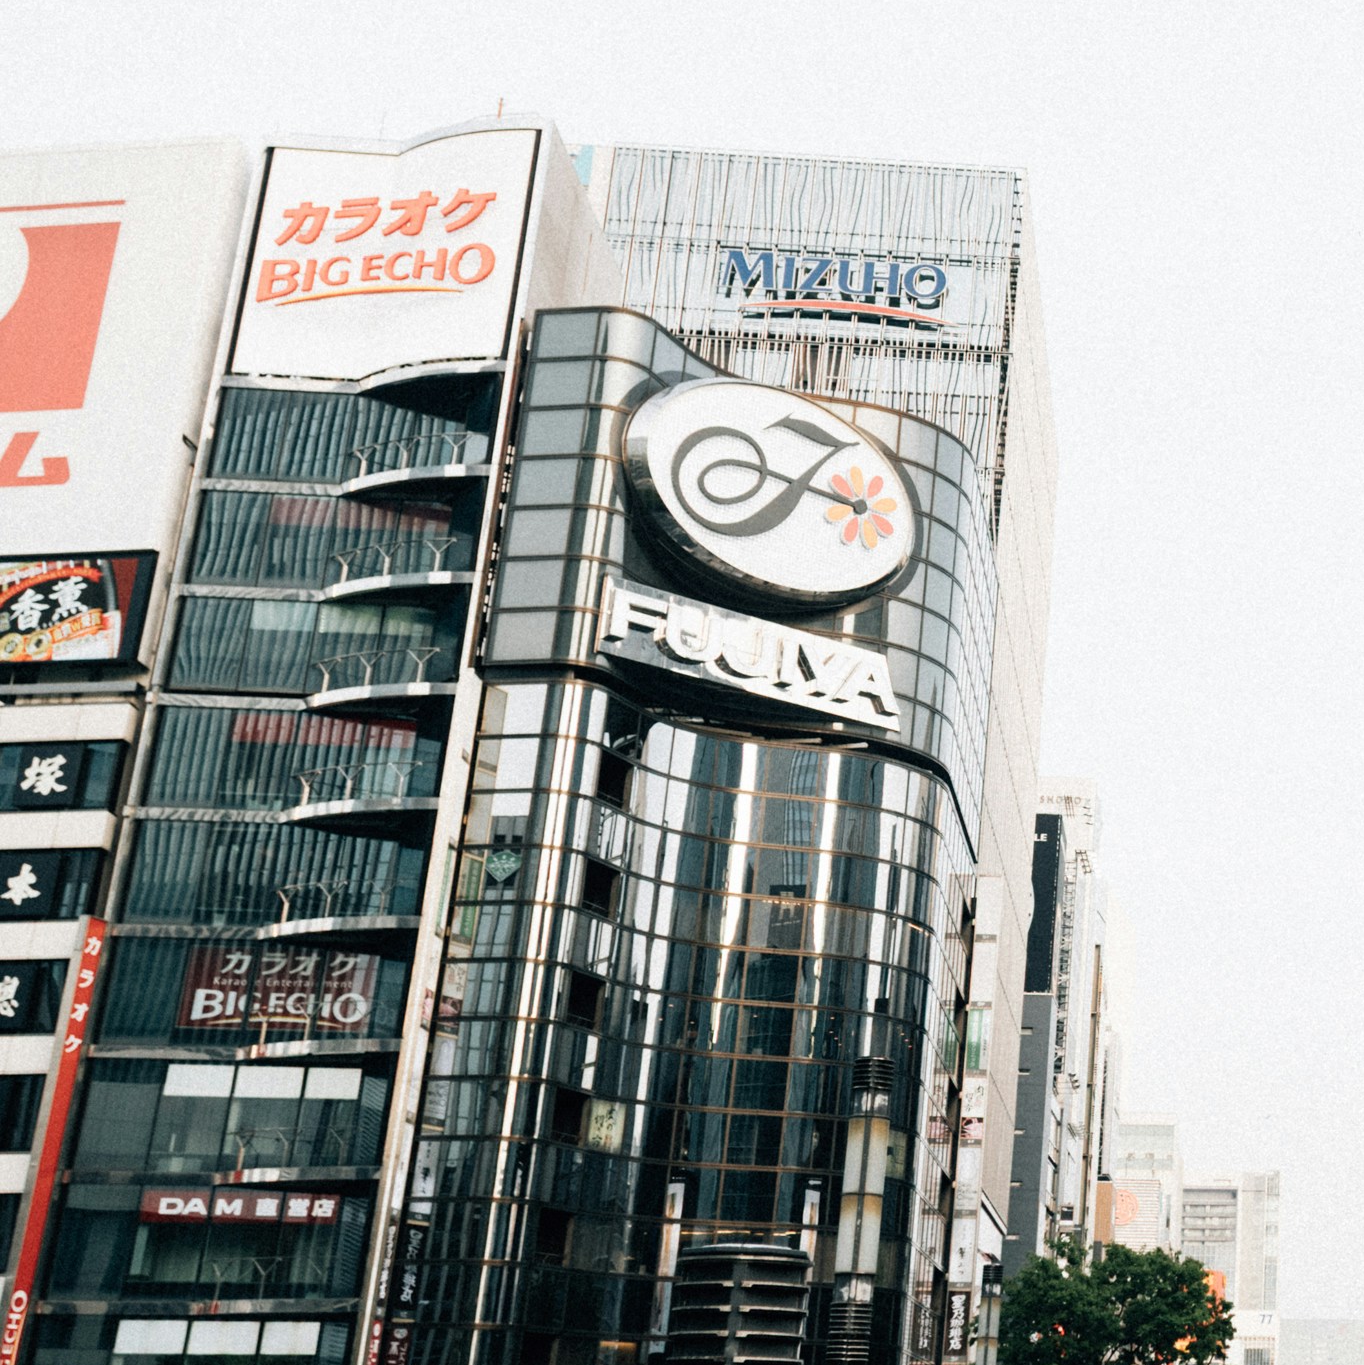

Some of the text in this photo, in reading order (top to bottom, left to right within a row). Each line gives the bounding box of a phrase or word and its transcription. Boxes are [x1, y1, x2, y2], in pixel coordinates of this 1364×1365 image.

[274, 188, 497, 247] カラオケ
[255, 242, 496, 303] BIG ECHO
[721, 248, 948, 301] MIZUHO
[602, 591, 899, 718] FUJIYA
[221, 951, 360, 977] カラオケ
[64, 936, 102, 1054] カラオケ
[157, 1197, 337, 1219] DAM 直営店
[2, 1290, 28, 1354] ECHO
